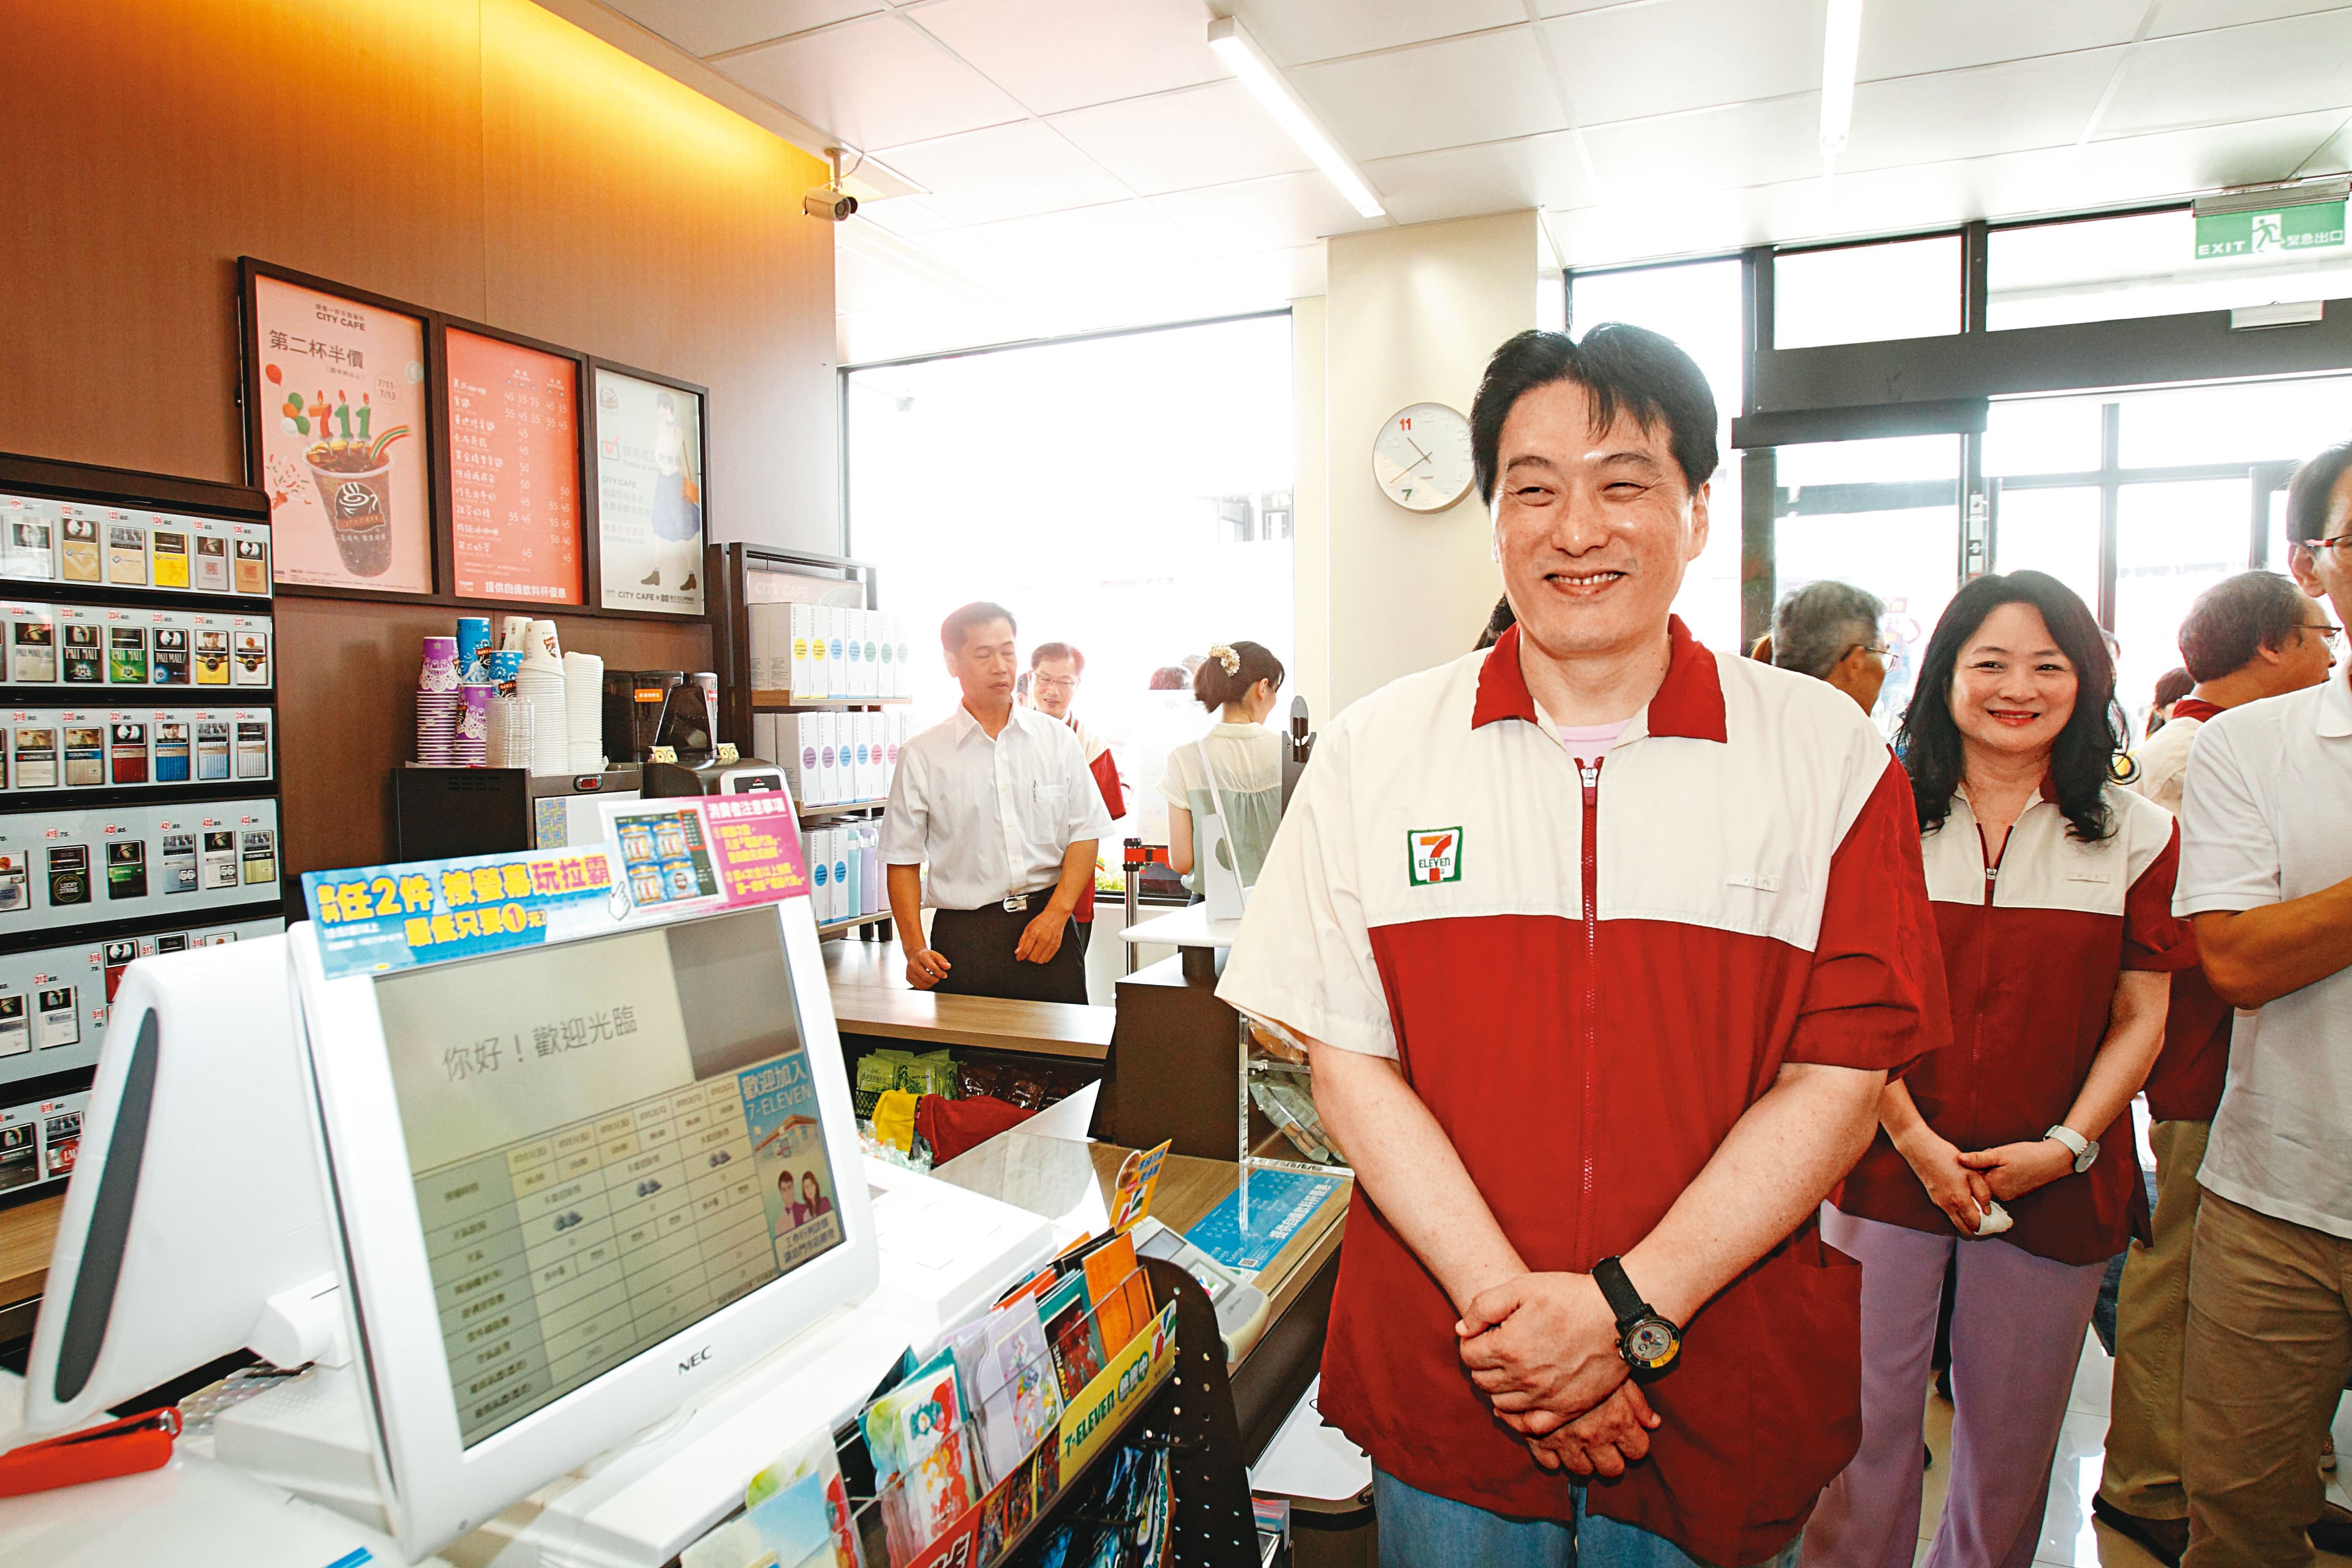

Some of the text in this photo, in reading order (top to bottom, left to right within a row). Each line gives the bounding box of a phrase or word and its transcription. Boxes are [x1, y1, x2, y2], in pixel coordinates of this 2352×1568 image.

[2286, 230, 2343, 246] 緊急出口
[2198, 240, 2245, 255] EXIT
[316, 312, 337, 324] CITY
[340, 318, 366, 331] CAFE
[270, 329, 364, 369] 第二杯半價
[1399, 418, 1411, 431] 11
[520, 462, 529, 472] 50
[520, 480, 529, 489] 50
[602, 476, 636, 488] CITY CAFE
[1402, 489, 1412, 501] 7
[509, 512, 518, 521] 55
[551, 535, 559, 544] 50
[484, 581, 567, 598] 提供自備飲料杯優惠
[156, 652, 183, 663] PALL MALL
[707, 797, 786, 820] 消費者注意事項
[1420, 834, 1452, 881] 7
[180, 870, 194, 880] 56
[221, 865, 235, 876] 56
[443, 1005, 638, 1082] 你好！歡迎光臨
[741, 1060, 808, 1101] 歡迎加入
[747, 1084, 812, 1121] 7-ELEVEN
[677, 1345, 712, 1376] NEC
